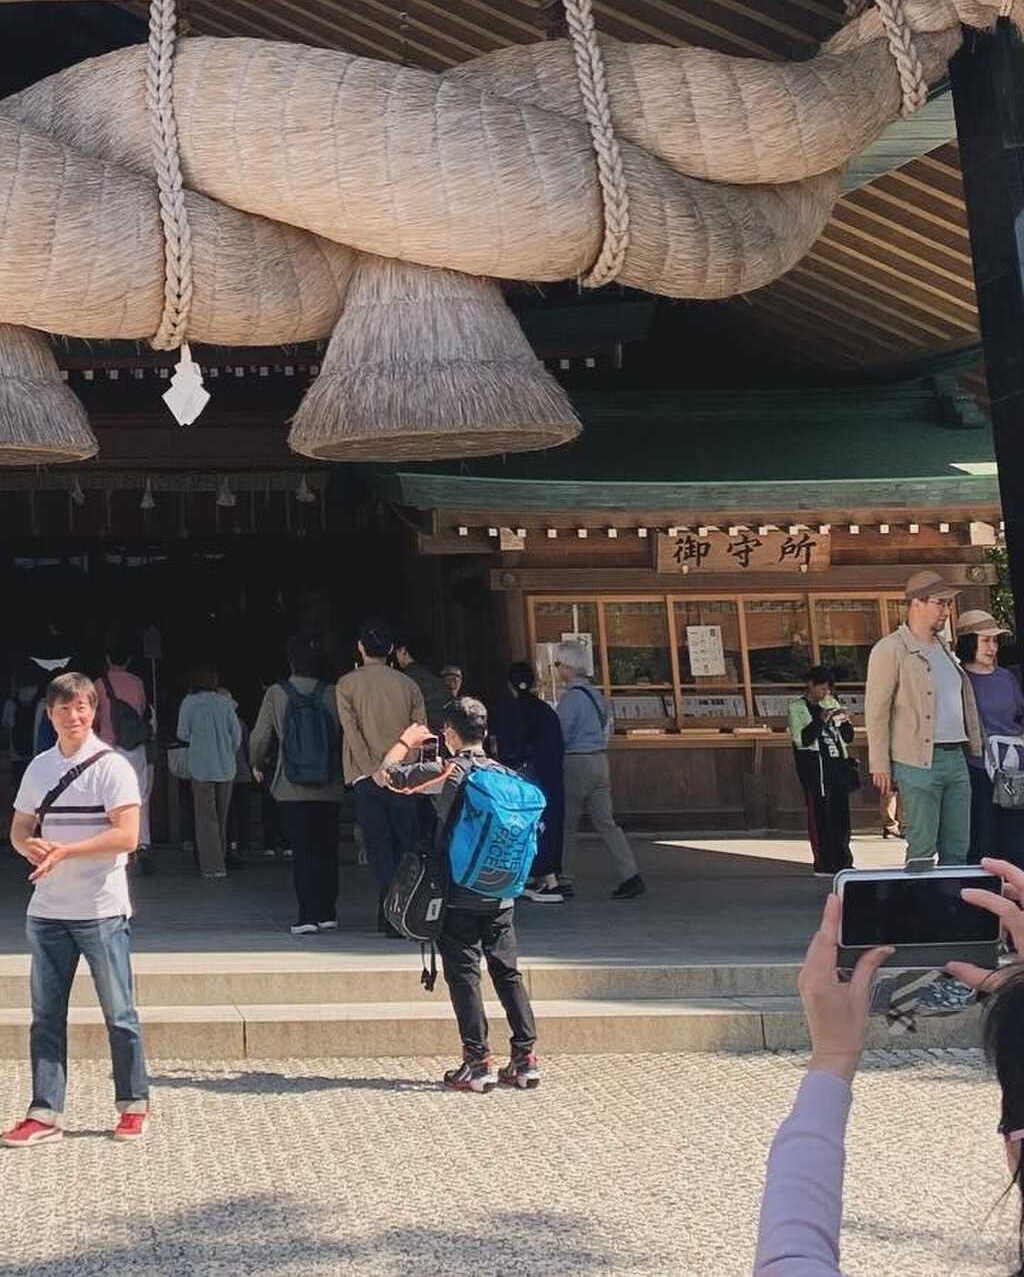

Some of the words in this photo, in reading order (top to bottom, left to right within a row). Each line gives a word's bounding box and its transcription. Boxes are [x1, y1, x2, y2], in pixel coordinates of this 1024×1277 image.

[673, 533, 816, 567] 御守所
[484, 826, 510, 867] FACE
